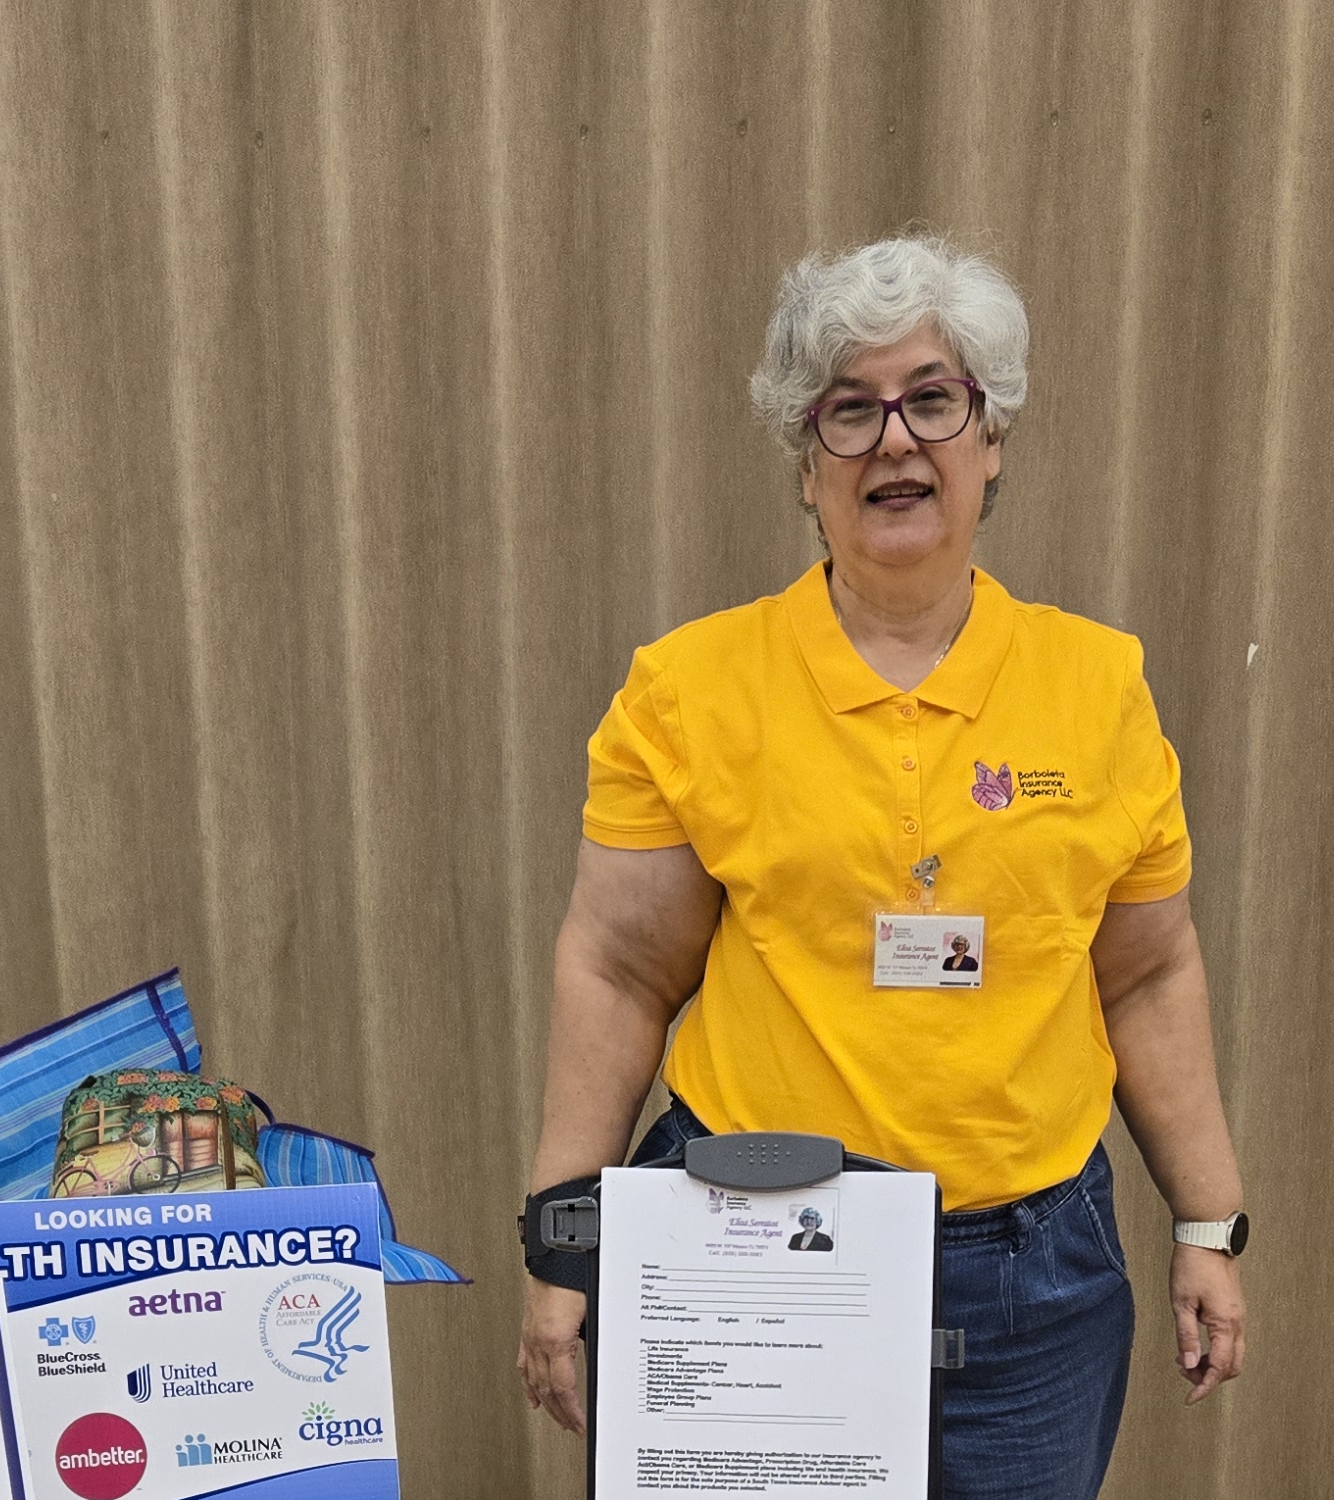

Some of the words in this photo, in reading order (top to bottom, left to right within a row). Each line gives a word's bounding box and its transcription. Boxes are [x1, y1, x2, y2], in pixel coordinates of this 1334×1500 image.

[1018, 769, 1065, 779] Borboleta
[1019, 779, 1063, 788] Insurance
[1021, 788, 1057, 798] Agency
[34, 1204, 153, 1231] LOOKING
[160, 1203, 213, 1225] FOR
[80, 1228, 360, 1276] INSURANCE?
[128, 1288, 223, 1317] aetna
[278, 1293, 321, 1310] ACA
[37, 1352, 101, 1365] BlueCross
[38, 1363, 107, 1377] BlueShield
[160, 1362, 218, 1381] United
[162, 1379, 254, 1399] Healthcare
[298, 1412, 383, 1447] cigna
[213, 1437, 283, 1455] MOLINA
[344, 1437, 384, 1446] healthcare
[214, 1450, 283, 1465] HEALTHCARE
